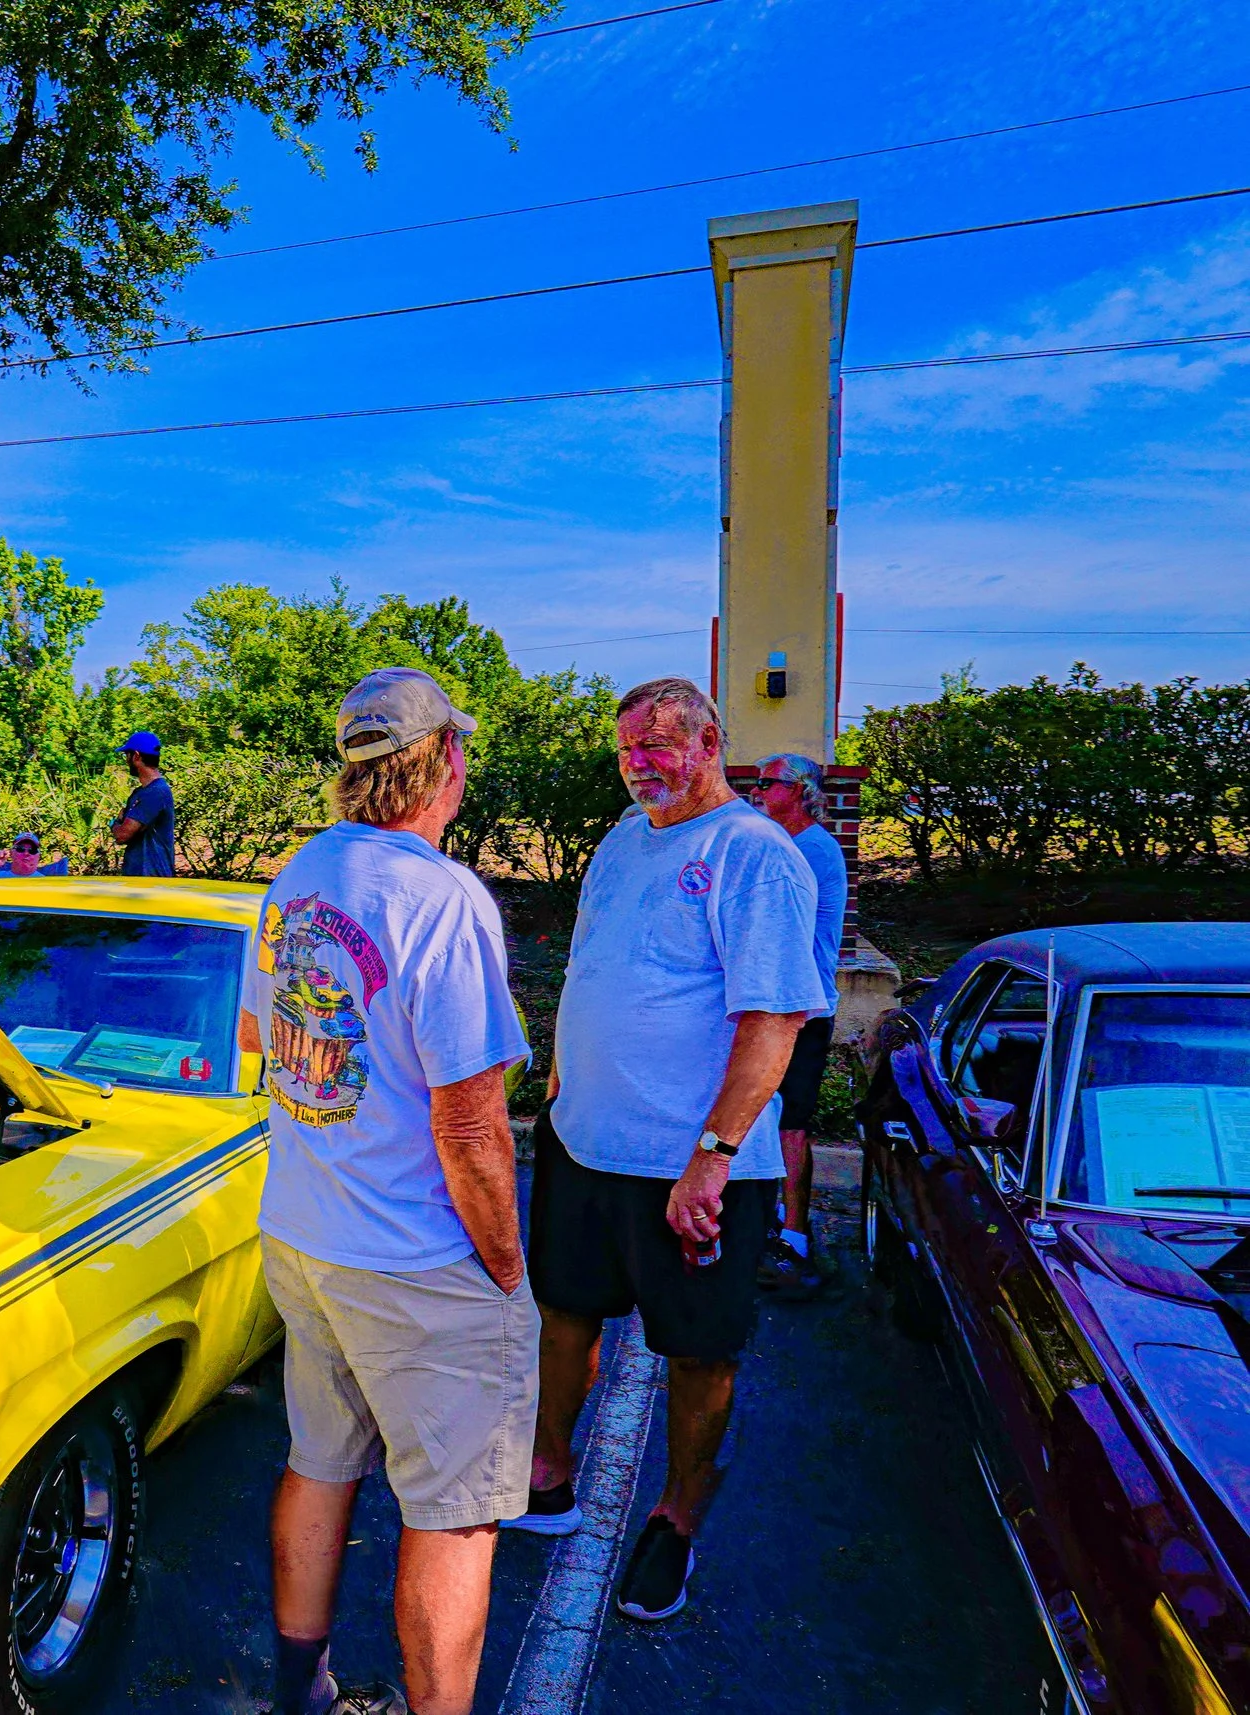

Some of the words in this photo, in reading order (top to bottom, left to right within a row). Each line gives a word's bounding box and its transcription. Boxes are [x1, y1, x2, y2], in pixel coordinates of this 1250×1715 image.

[316, 905, 368, 957] MOTHERS
[359, 957, 374, 994] CLEANERS
[302, 1109, 315, 1124] Like
[320, 1108, 355, 1126] MOTHERS
